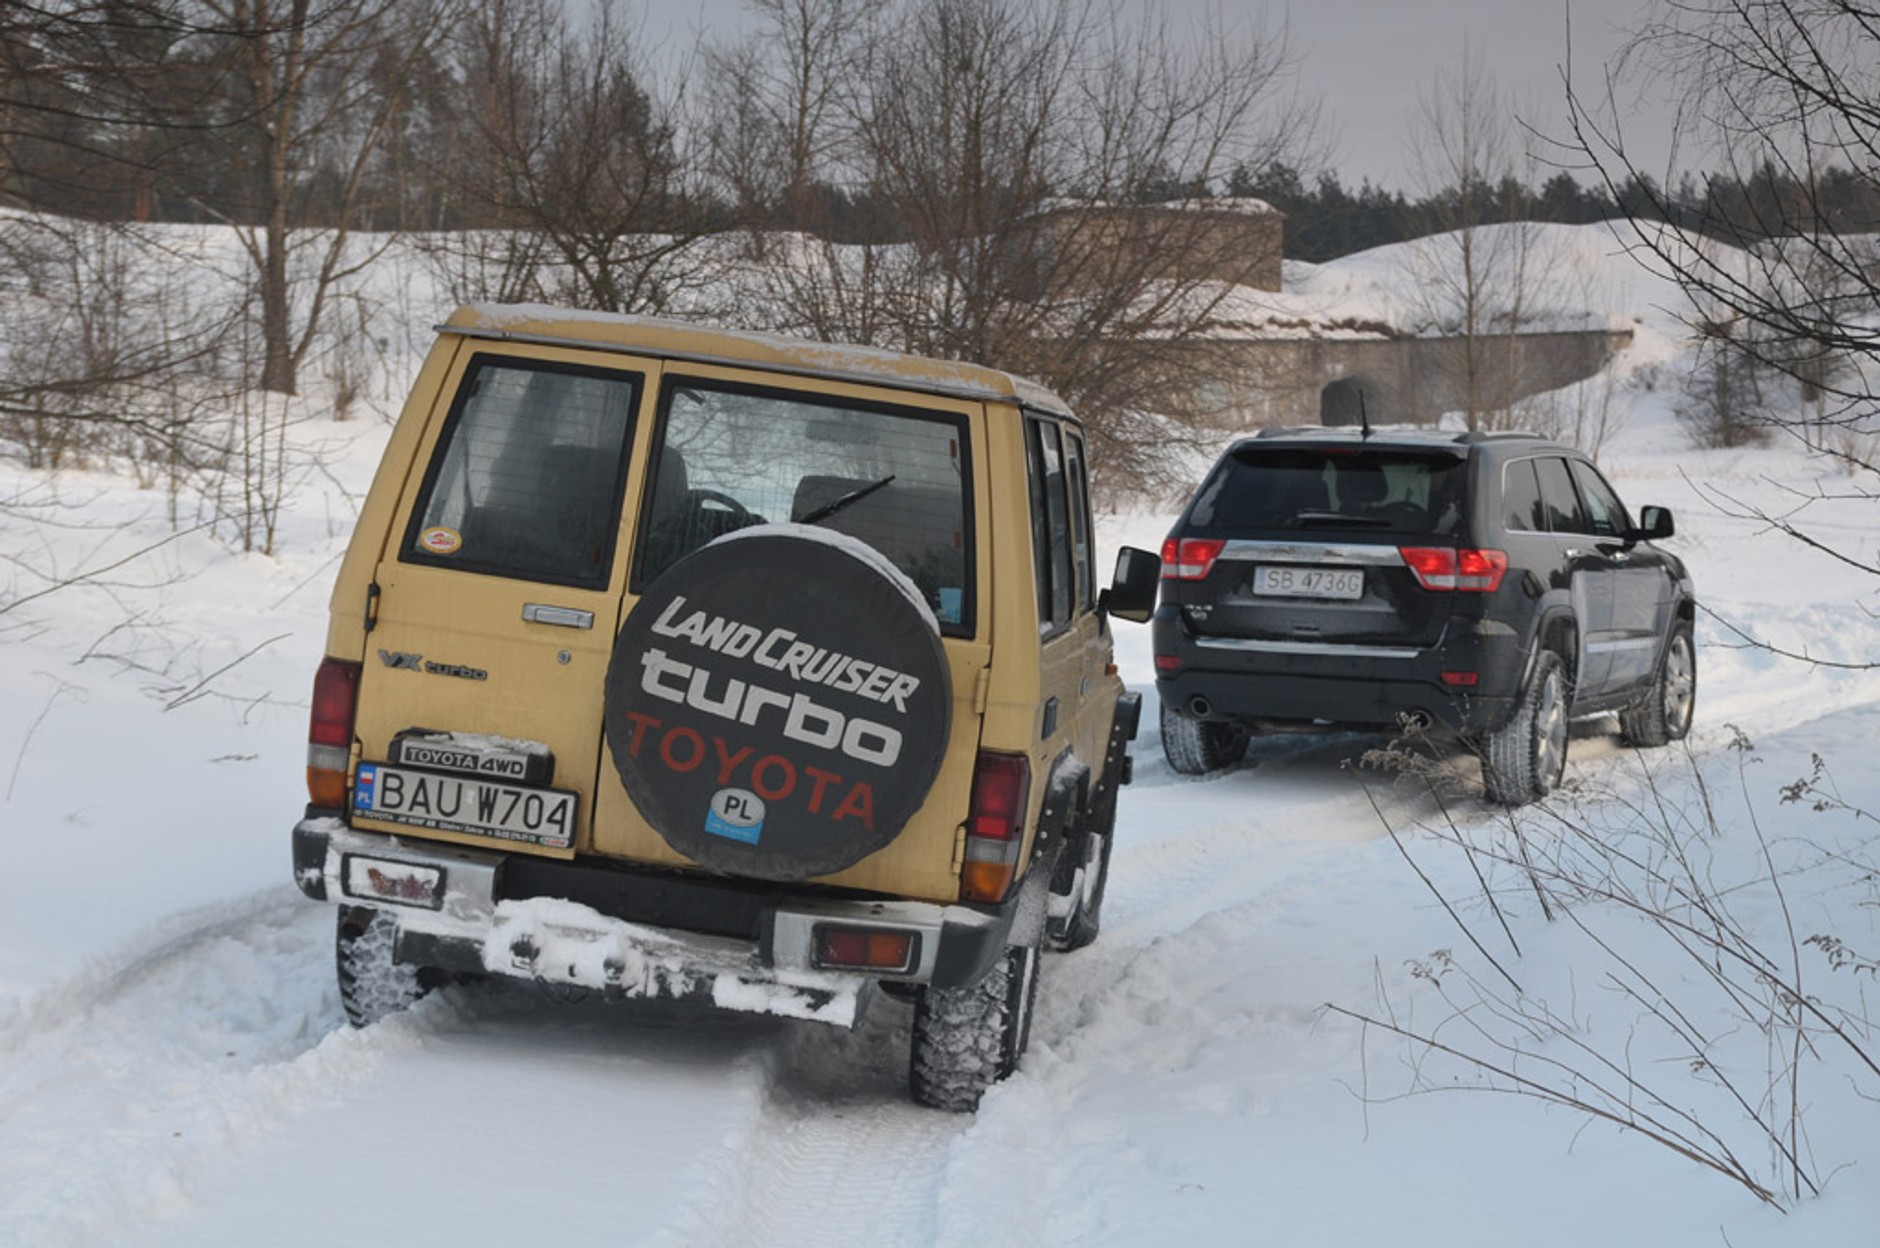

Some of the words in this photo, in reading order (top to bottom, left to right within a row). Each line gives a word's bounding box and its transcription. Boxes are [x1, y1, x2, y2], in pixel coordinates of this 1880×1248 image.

[1267, 570, 1293, 589] SB
[377, 649, 424, 673] VX
[425, 660, 488, 681] turbo
[640, 647, 903, 767] turbo
[408, 748, 475, 769] TOYOTA
[480, 757, 524, 776] 4WD
[625, 711, 875, 831] TOYOTA
[380, 772, 463, 818] BAU
[477, 785, 568, 835] W704
[723, 794, 752, 820] PL
